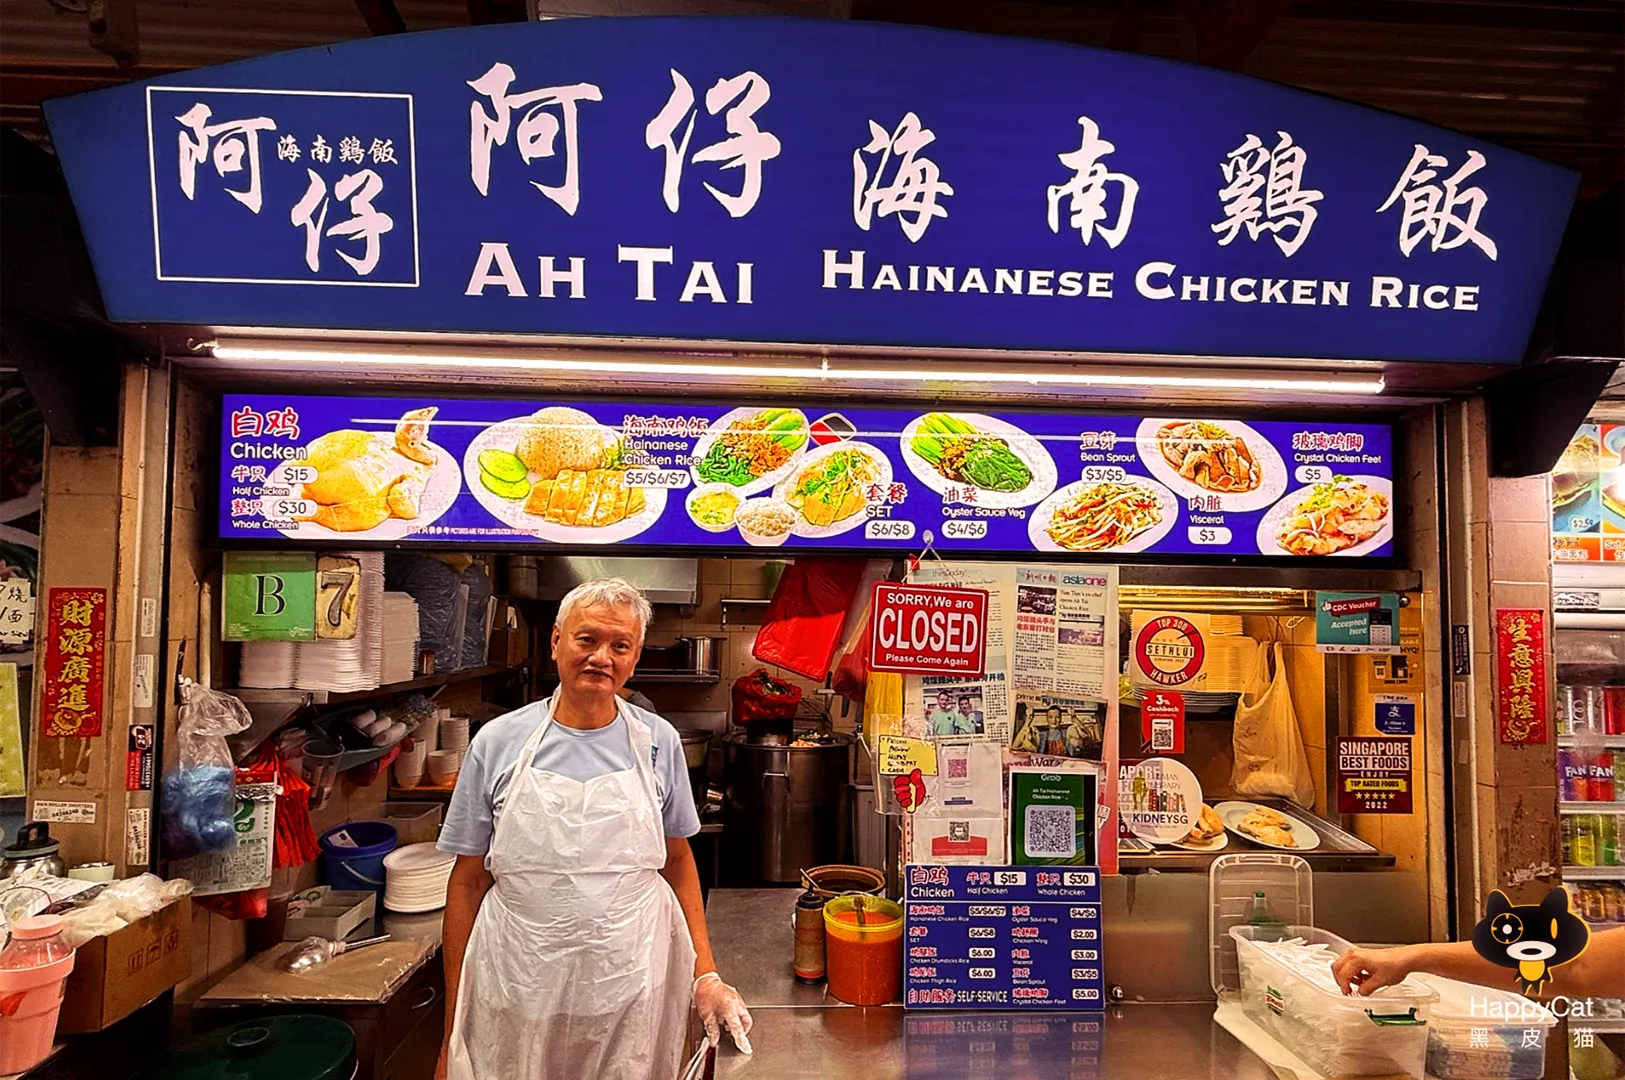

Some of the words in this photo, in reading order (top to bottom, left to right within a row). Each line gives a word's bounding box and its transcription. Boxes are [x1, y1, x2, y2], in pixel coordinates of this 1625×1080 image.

[176, 103, 277, 215] 阿
[291, 169, 394, 276] 仔
[465, 242, 586, 300] AH
[618, 244, 754, 305] TAI
[821, 249, 1114, 300] HAINANESE
[1134, 262, 1350, 308] CHICKEN
[1370, 276, 1480, 312] RICE
[232, 406, 300, 440] 白鸡
[623, 415, 709, 438] 海南鸡饭
[624, 439, 688, 450] Hainanese
[1080, 431, 1116, 450] 豆芽
[1292, 431, 1364, 451] 玻璃鸡脚
[230, 442, 308, 460] Chicken
[624, 454, 672, 466] Chicken
[675, 454, 700, 466] Rice
[1080, 453, 1105, 462] Bean
[1106, 453, 1136, 463] Sprout
[1294, 453, 1324, 464] Crystal
[1326, 453, 1360, 463] Chicken
[1362, 454, 1382, 463] Feet
[283, 467, 308, 482] $15
[626, 472, 687, 486] $5/$6/$7
[1086, 468, 1122, 482] $3/$5
[1305, 468, 1321, 481] $5
[232, 486, 252, 497] Half
[253, 486, 290, 497] Chicken
[865, 482, 908, 504] 套餐
[942, 485, 978, 504] 油菜
[278, 501, 307, 515] $30
[866, 505, 893, 518] SET
[942, 507, 973, 518] Oyster
[975, 507, 1006, 517] Sauce
[1007, 508, 1026, 519] Veg
[232, 520, 261, 530] Whole
[262, 520, 299, 530] Chicken
[1189, 515, 1224, 524] Visceral
[872, 522, 910, 536] $6/$8
[947, 522, 985, 536] $4/$6
[1199, 530, 1216, 543] $3
[252, 573, 287, 617] B
[320, 571, 355, 627] 7
[955, 600, 974, 609] are
[1332, 603, 1348, 611] CDC
[1349, 601, 1377, 610] Voucher
[1157, 619, 1171, 629] TOP
[1331, 618, 1367, 629] Accepted
[879, 608, 979, 653] CLOSED
[1349, 627, 1367, 635] here
[1147, 644, 1193, 657] SETHLUI
[886, 653, 914, 663] Please
[916, 655, 941, 664] Come
[943, 657, 969, 667] Again
[1149, 669, 1188, 684] HAWKER
[1146, 705, 1179, 713] Cashback
[1340, 742, 1409, 756] SINGAPORE
[1342, 757, 1369, 769] BEST
[1372, 757, 1407, 769] FOODS
[1365, 801, 1388, 809] 2022
[1133, 813, 1189, 824] KIDNEYSG
[910, 866, 949, 886] 白鸡
[1000, 873, 1018, 884] $15
[1069, 874, 1089, 885] $30
[911, 887, 954, 898] Chicken
[967, 887, 981, 896] Half
[982, 887, 1008, 895] Chicken
[969, 906, 1005, 916] $5/$6/$7
[1071, 909, 1096, 918] $4/$6
[970, 928, 994, 937] $6/$8
[1073, 931, 1094, 939] $2.00
[972, 949, 993, 957] $6.00
[1074, 951, 1095, 960] $3.00
[972, 970, 993, 978] $6.00
[1073, 970, 1098, 979] $3/$5
[956, 990, 1008, 1003] SELF-SERVICE
[1074, 990, 1097, 998] $5.00
